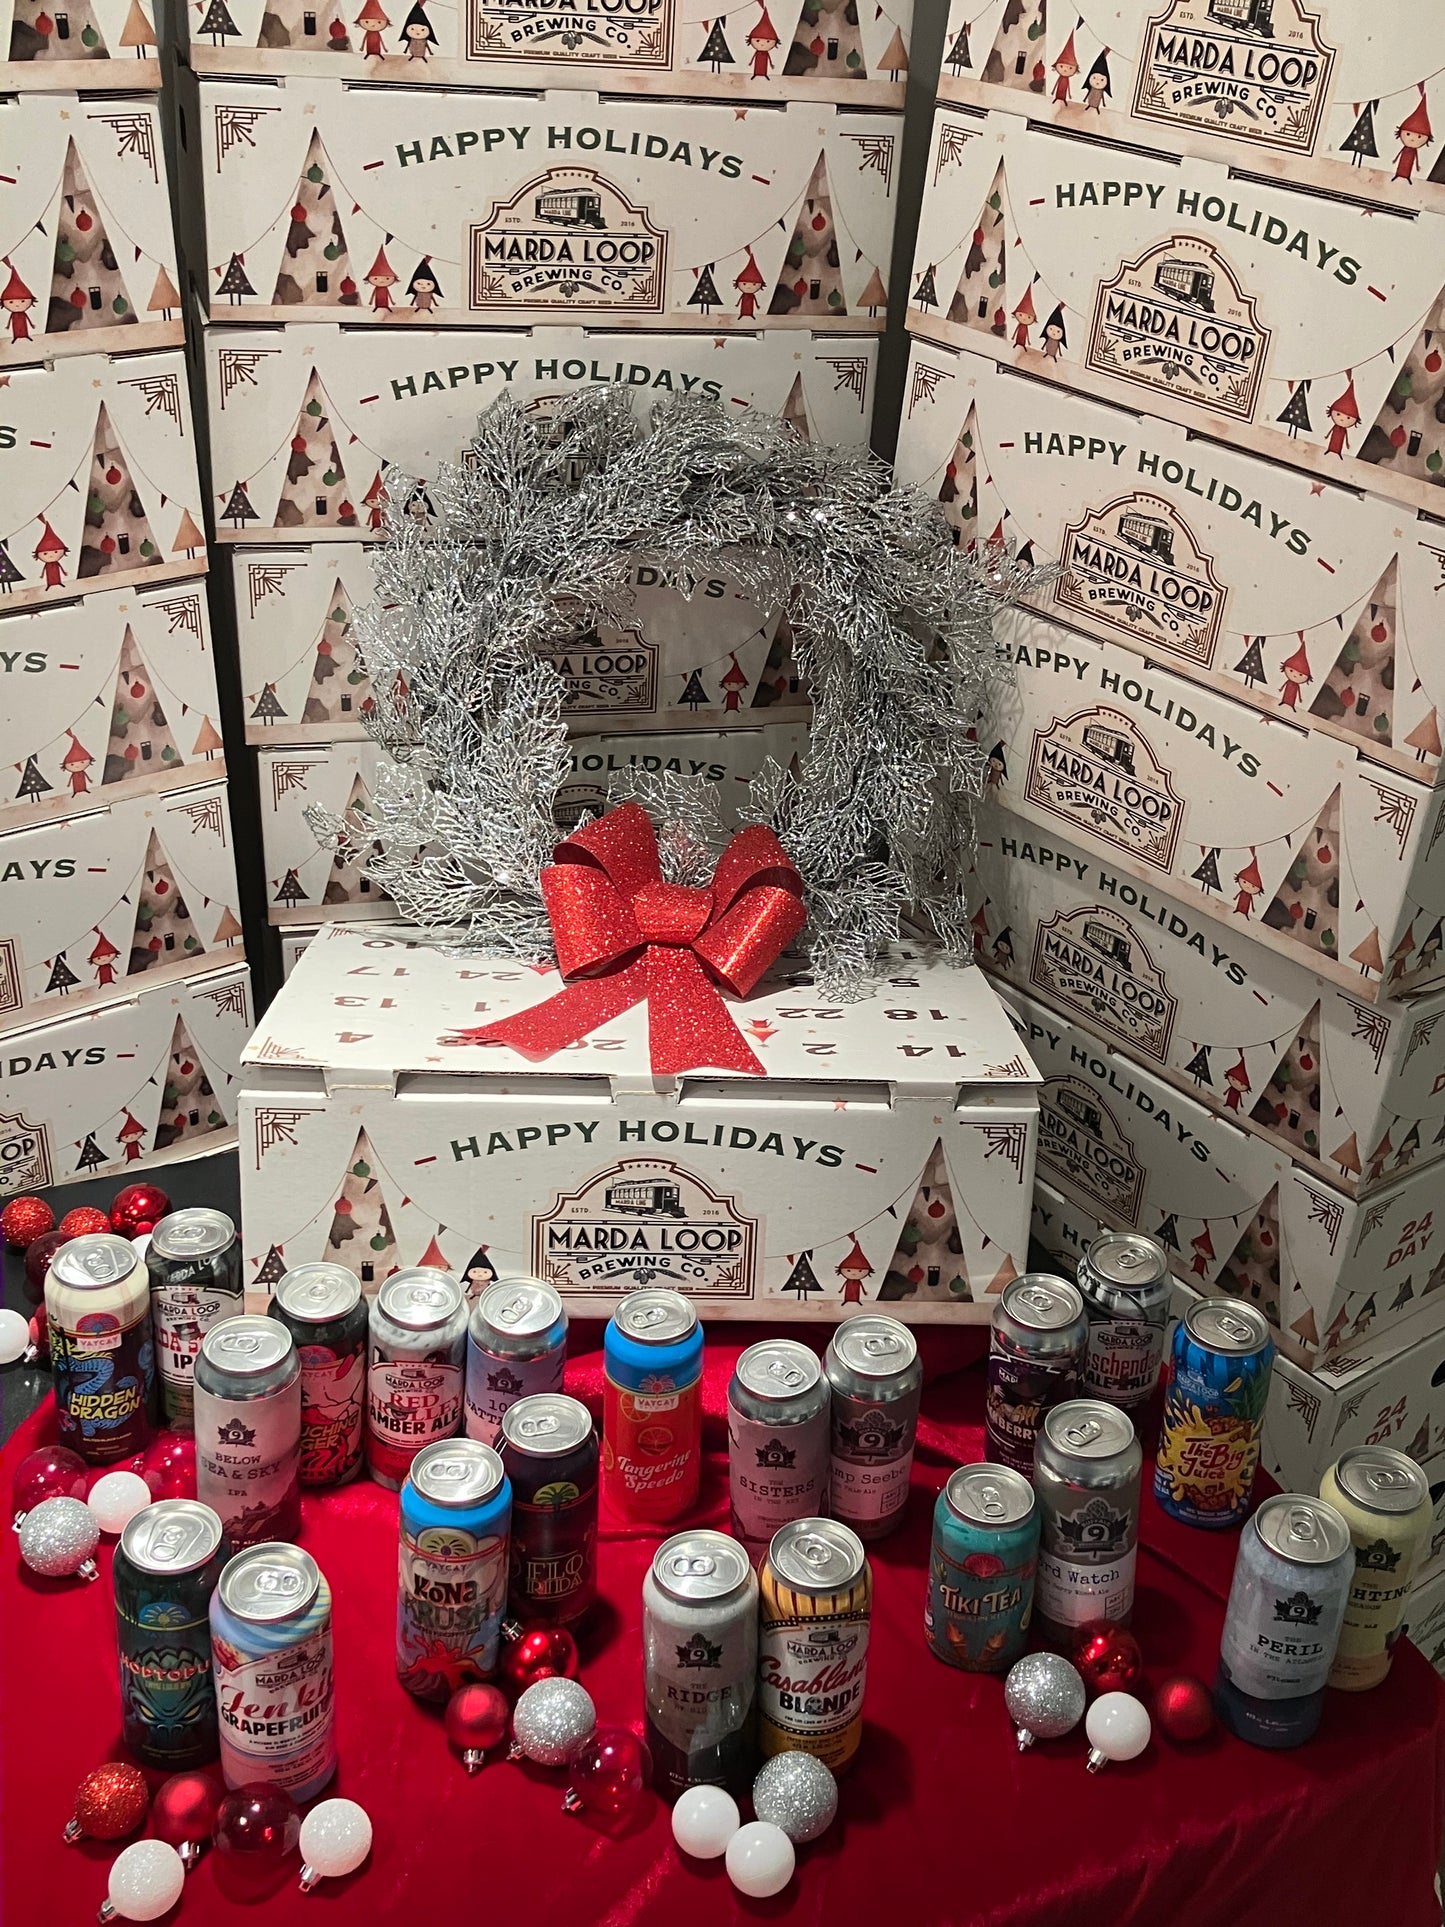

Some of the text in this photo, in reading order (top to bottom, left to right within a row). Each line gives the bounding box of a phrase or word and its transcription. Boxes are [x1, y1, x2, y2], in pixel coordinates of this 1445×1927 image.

[511, 17, 632, 48] BREWING CO.
[1154, 33, 1318, 88] MARDA LOOP
[1172, 82, 1278, 126] BREWING CO.
[396, 126, 744, 178] HAPPY HOLIDAYS
[1056, 182, 1363, 286] HAPPY HOLIDAYS
[485, 236, 656, 264] MARDA LOOP
[512, 268, 626, 295] BREWING CO.
[1106, 296, 1256, 362] MARDA LOOP
[390, 359, 723, 402] HAPPY HOLIDAYS
[1124, 344, 1220, 392] BREWING CO.
[1024, 432, 1312, 556] HAPPY HOLIDAYS
[1072, 540, 1213, 614] MARDA LOOP
[1088, 582, 1180, 638] BREWING CO.
[584, 655, 648, 676] LOOP
[600, 684, 621, 700] CO.
[1100, 669, 1262, 778] HOLIDAYS
[1040, 744, 1172, 822] MARDA LOOP
[1056, 790, 1118, 818] BREWING
[1124, 818, 1142, 844] CO.
[1001, 838, 1248, 986] HAPPY HOLIDAYS
[346, 966, 524, 981] 17 24
[888, 978, 920, 988] 5
[1045, 935, 1166, 1018] MARDA LOOP
[334, 996, 398, 1009] 13
[1060, 977, 1117, 1008] BREWING
[775, 1007, 949, 1021] 22 18
[334, 1031, 374, 1044] 4
[802, 1042, 967, 1058] 2 14
[1070, 1044, 1212, 1162] HOLIDAYS
[0, 1138, 34, 1162] OP
[451, 1120, 846, 1168] HAPPY HOLIDAYS
[1084, 1140, 1134, 1183] LOOP
[548, 1226, 742, 1252] MARDA LOOP
[1398, 1211, 1434, 1245] 24
[1383, 1230, 1434, 1271] DAY
[578, 1256, 709, 1282] BREWING CO.
[158, 1302, 221, 1316] MARDA LOOP
[174, 1353, 193, 1370] IP
[1087, 1370, 1113, 1390] ALE
[70, 1396, 140, 1420] DRAGON
[72, 1385, 137, 1408] HIDDEN
[390, 1392, 440, 1409] RED
[302, 1411, 360, 1438] UCHING
[370, 1404, 459, 1434] AMBER ALE
[1373, 1395, 1408, 1430] 24
[302, 1434, 338, 1450] GER
[1364, 1412, 1408, 1445] DAY
[216, 1452, 262, 1466] BELOW
[618, 1450, 691, 1480] Tangerine
[1178, 1451, 1226, 1480] Juice
[1186, 1438, 1246, 1470] The Big
[201, 1456, 282, 1480] SEA & SKY
[625, 1469, 684, 1492] Speedo
[228, 1488, 248, 1496] IPA
[740, 1476, 814, 1498] SISTERS
[1088, 1526, 1105, 1542] 9
[1068, 1570, 1120, 1585] Watch
[940, 1584, 980, 1615] TIKI
[983, 1586, 1020, 1614] TEA
[1352, 1581, 1412, 1602] HTING
[787, 1640, 826, 1658] MARDA
[1258, 1634, 1324, 1656] PERIL
[256, 1671, 298, 1686] MARDA
[760, 1654, 868, 1695] Casablan
[667, 1685, 732, 1704] RIDGE
[222, 1699, 329, 1736] GRAPEFRUIT
